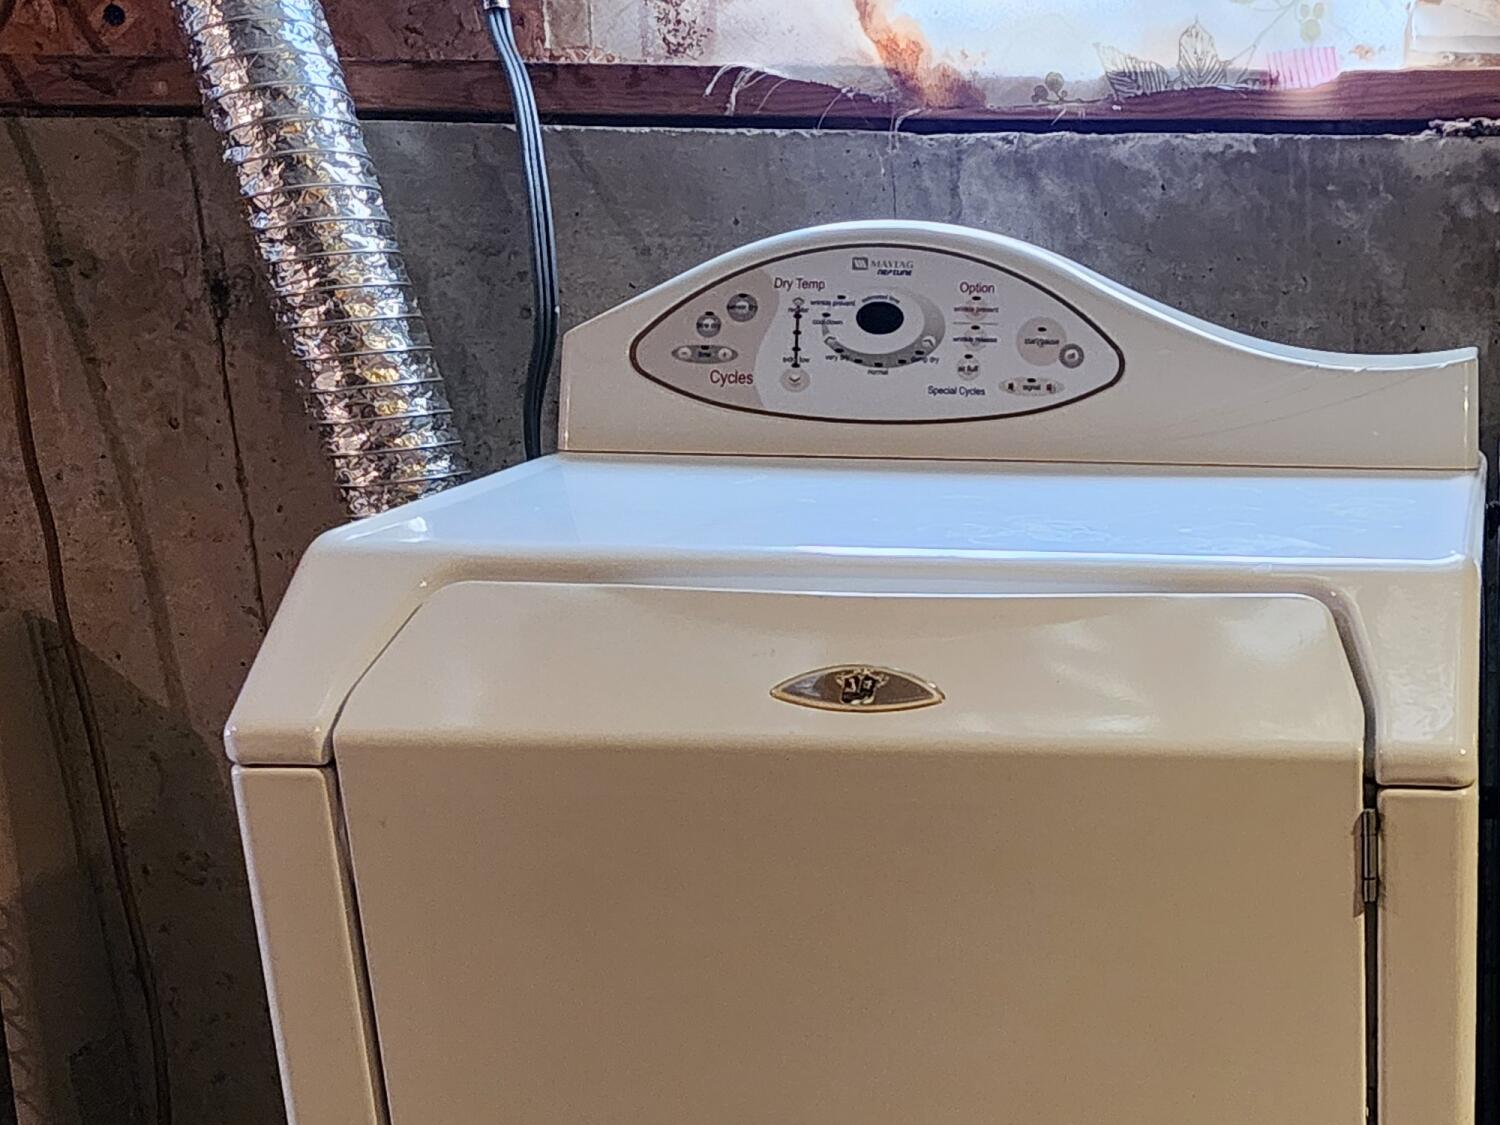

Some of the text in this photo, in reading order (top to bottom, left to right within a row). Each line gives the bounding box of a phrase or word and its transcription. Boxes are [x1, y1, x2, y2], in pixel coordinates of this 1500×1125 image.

[774, 277, 826, 291] Dry Temp
[960, 281, 995, 295] Option
[710, 369, 754, 387] Cycles
[928, 385, 986, 397] Special Cycles
